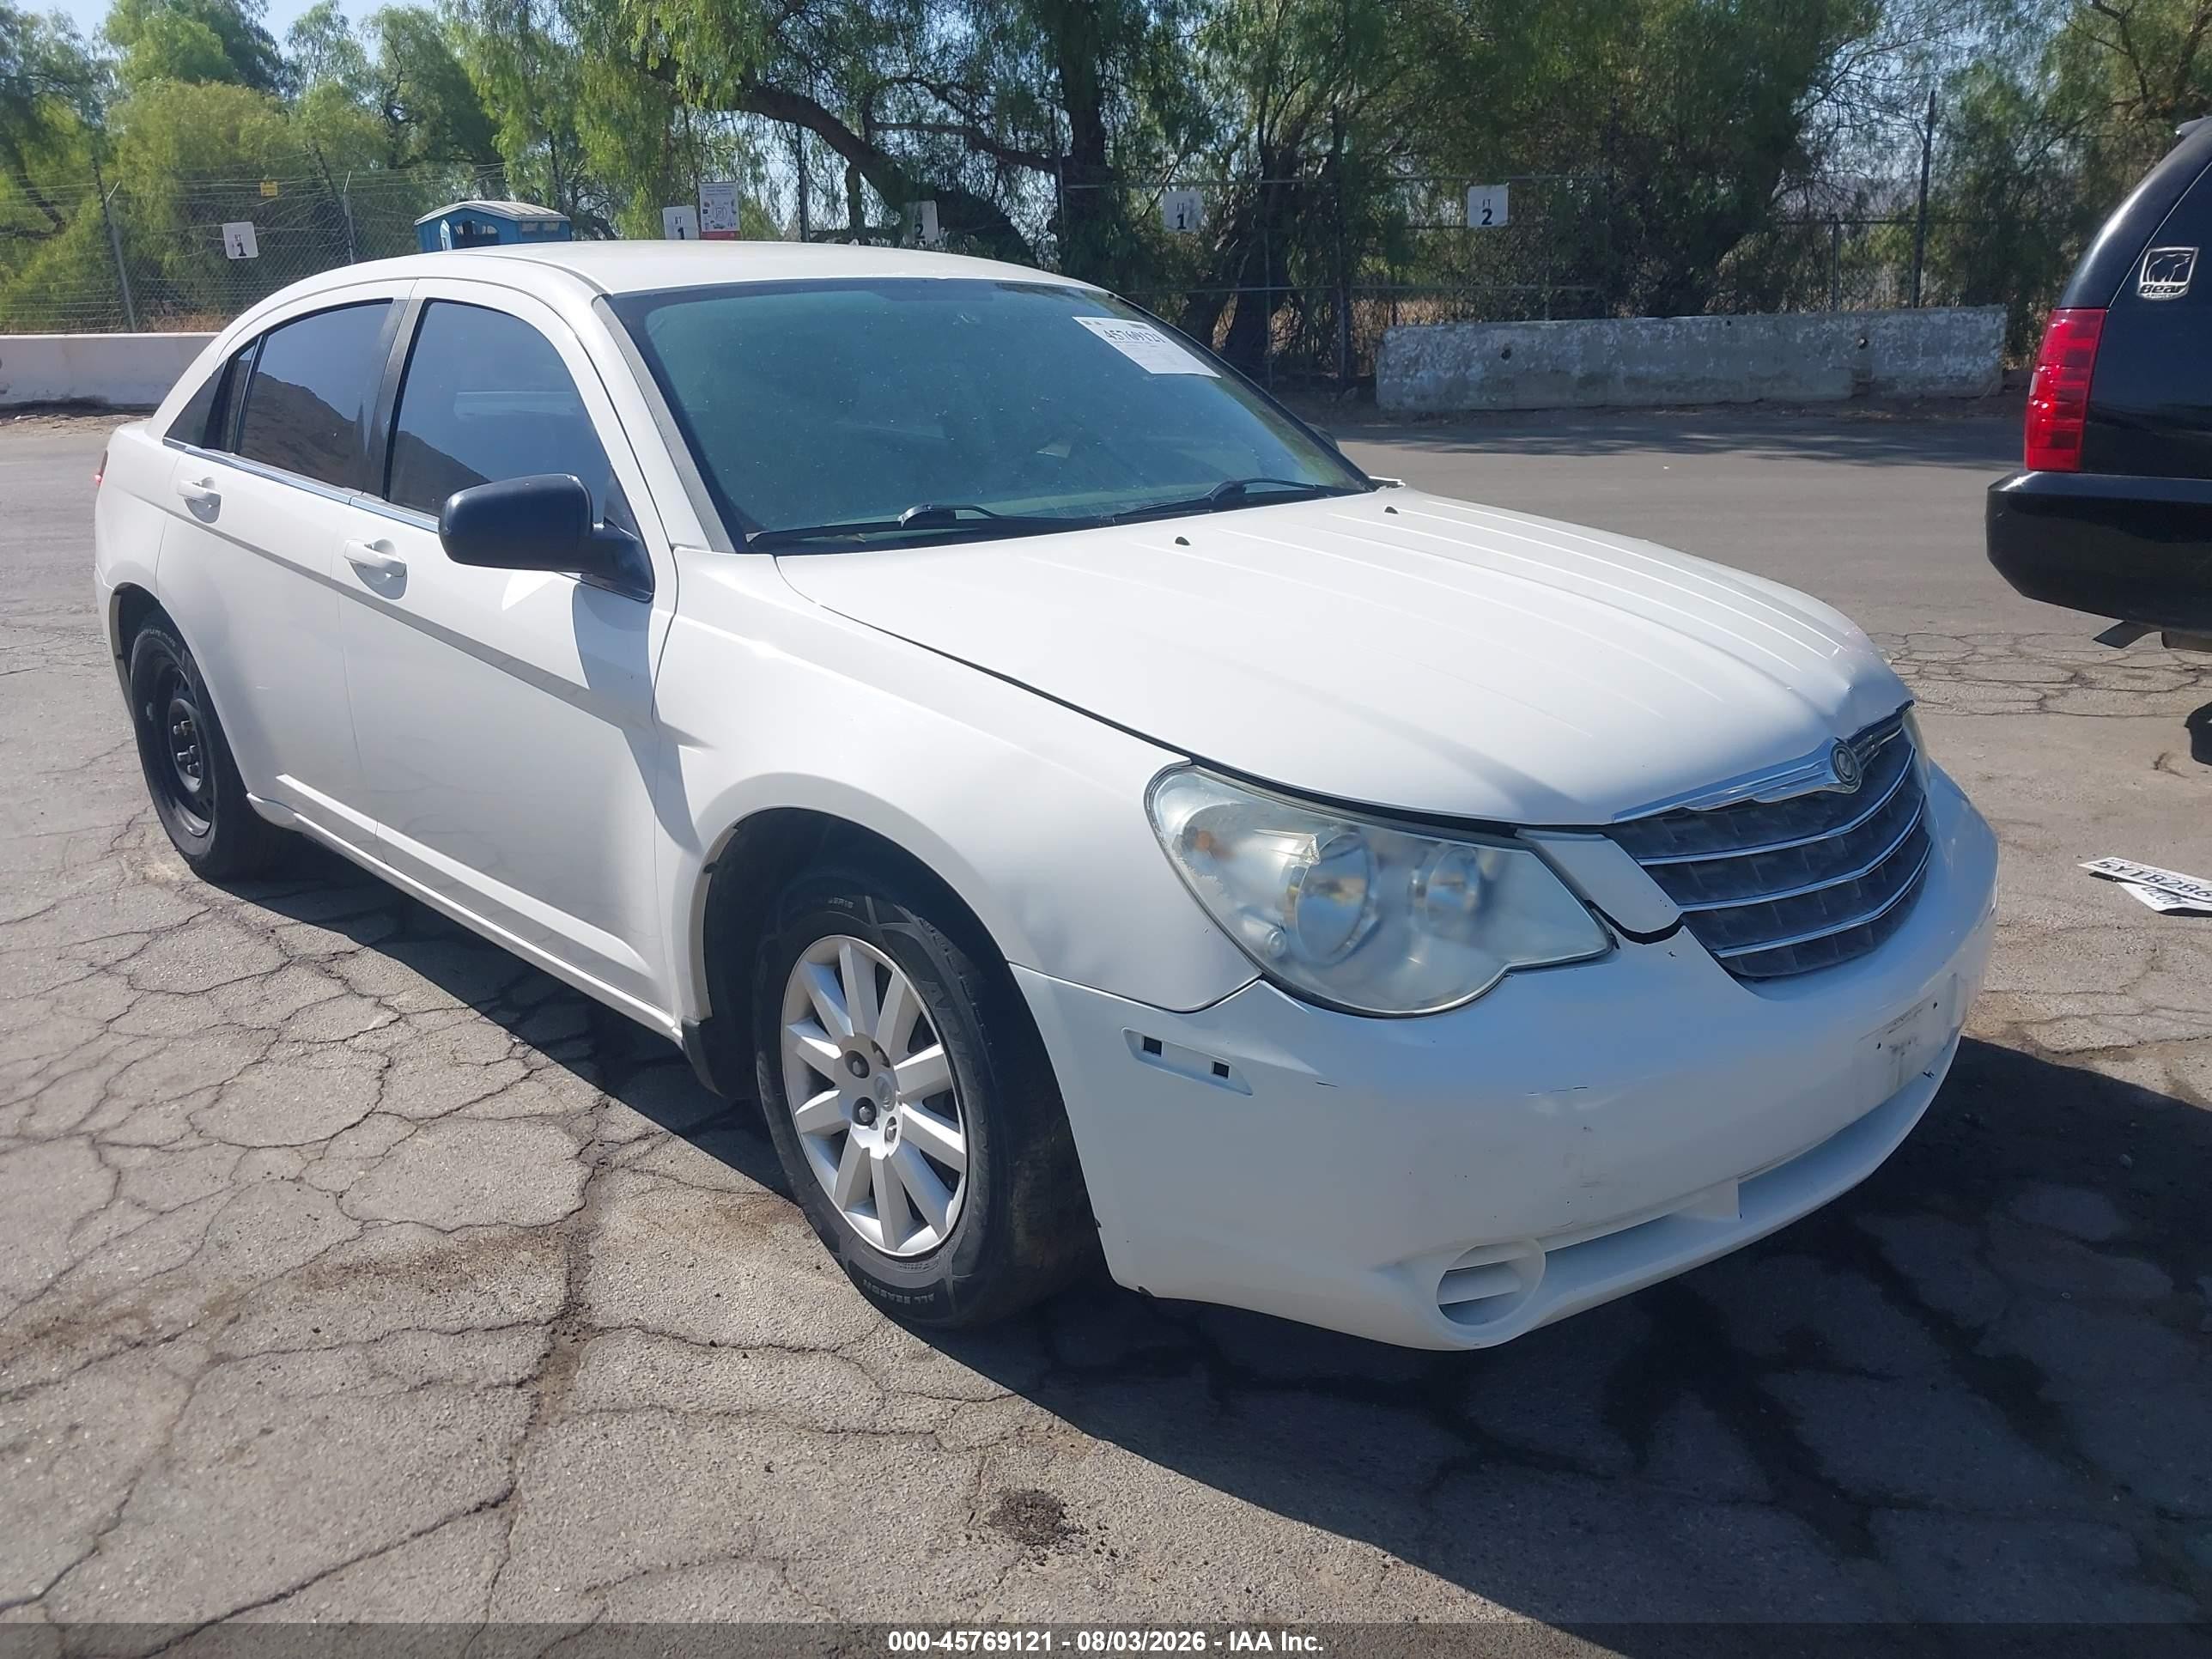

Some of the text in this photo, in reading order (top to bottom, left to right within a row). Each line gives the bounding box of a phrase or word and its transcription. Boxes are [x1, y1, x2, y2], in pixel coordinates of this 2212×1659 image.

[1176, 214, 1187, 230] 1
[1481, 209, 1493, 226] 2
[678, 227, 685, 240] 1
[915, 224, 926, 239] 2
[237, 242, 247, 257] 1
[1103, 329, 1167, 343] 45769121
[2089, 860, 2212, 897] 5YTB286
